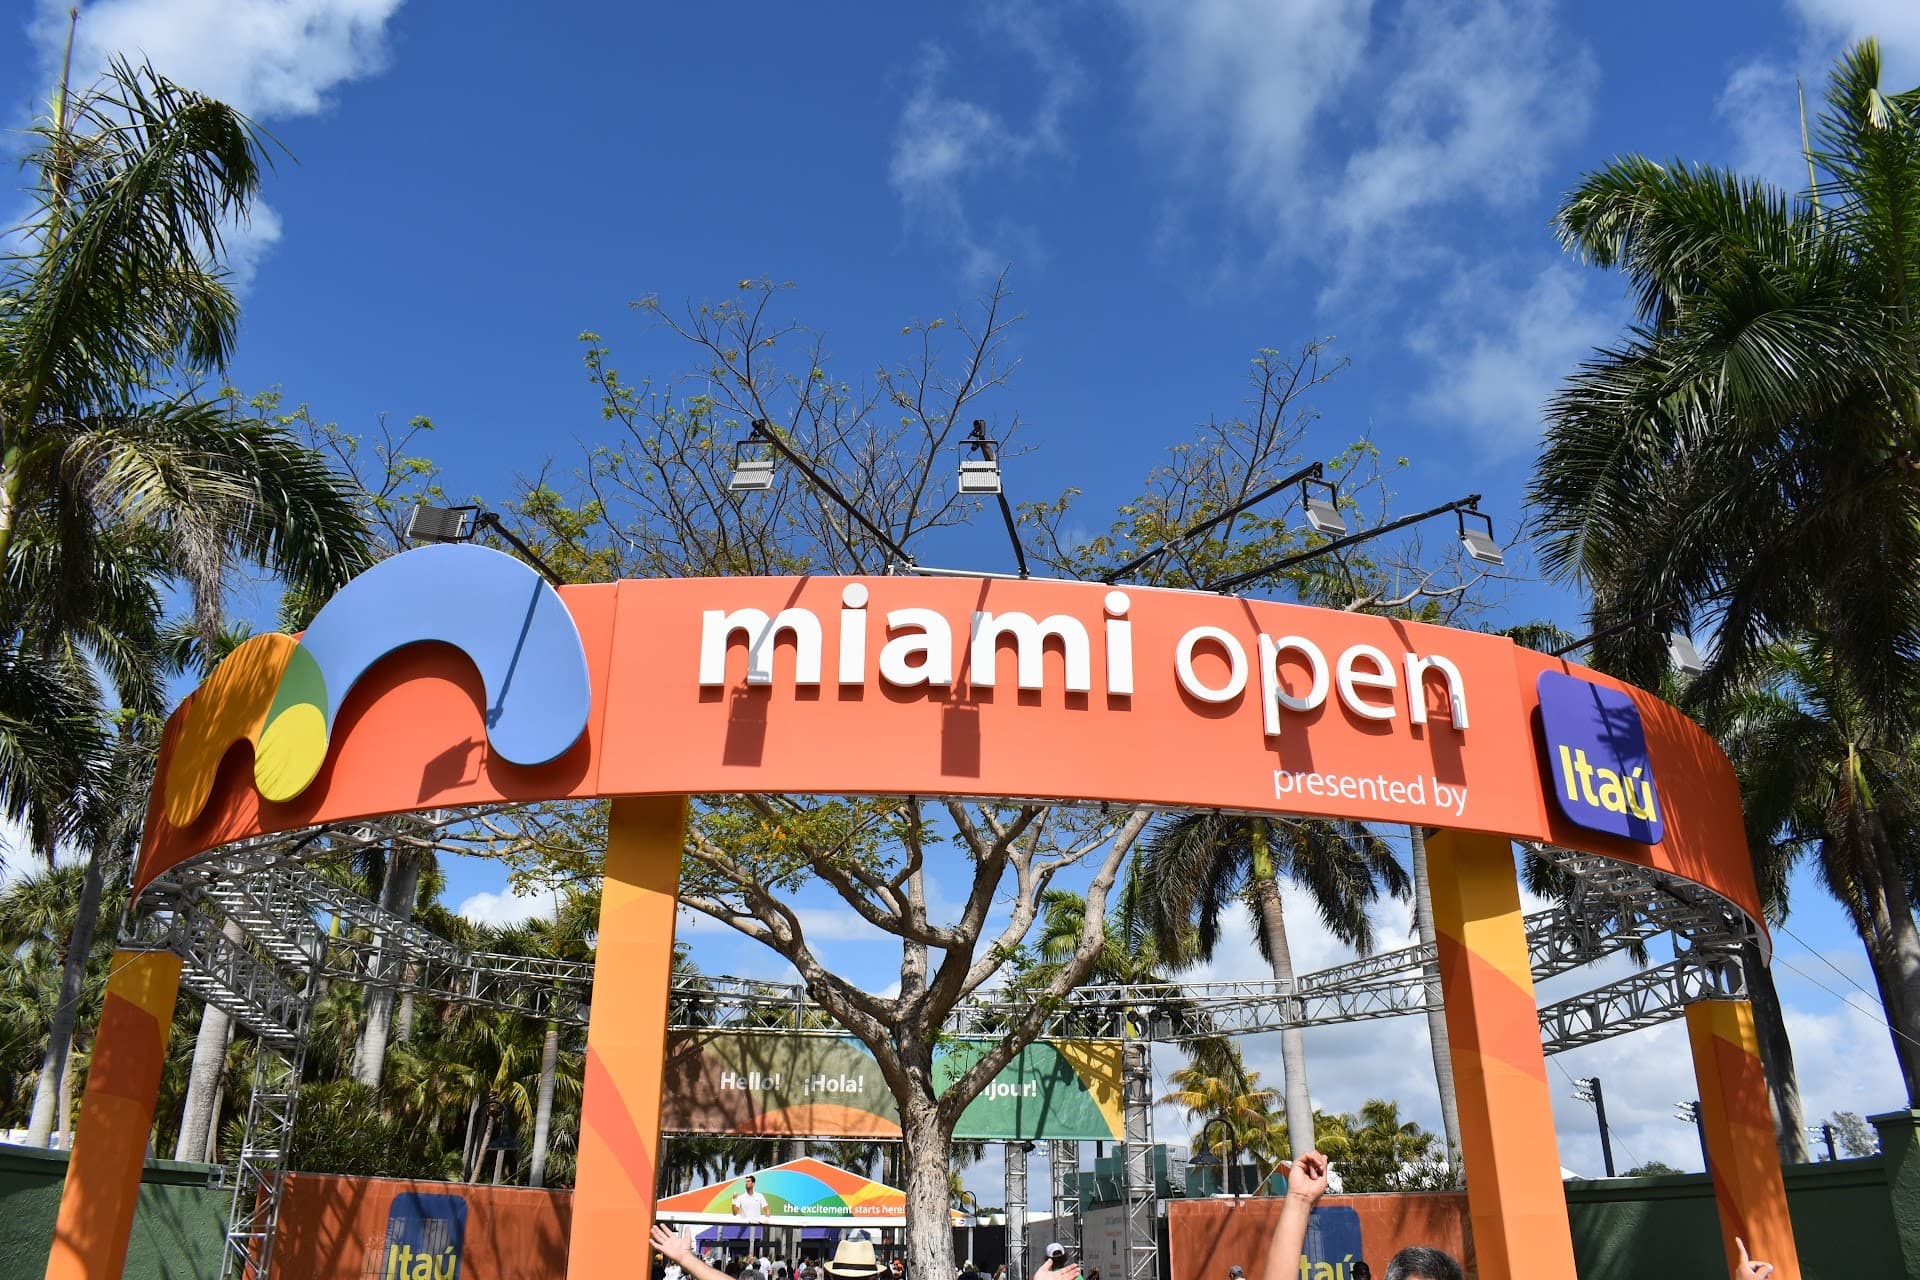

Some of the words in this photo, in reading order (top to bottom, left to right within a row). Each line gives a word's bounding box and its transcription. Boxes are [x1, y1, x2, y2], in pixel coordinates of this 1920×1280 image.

[698, 582, 1135, 696] miami
[1175, 625, 1470, 736] open
[1273, 769, 1426, 805] presented
[1432, 776, 1468, 817] by
[1559, 745, 1657, 822] Itaú
[720, 1071, 781, 1091] Hello!
[804, 1073, 864, 1096] ¡Hola!
[951, 1077, 1037, 1101] jour!
[783, 1204, 799, 1213] the
[801, 1204, 851, 1215] excitement
[854, 1205, 880, 1214] starts
[386, 1244, 457, 1280] Itaú
[1299, 1254, 1356, 1280] taú
